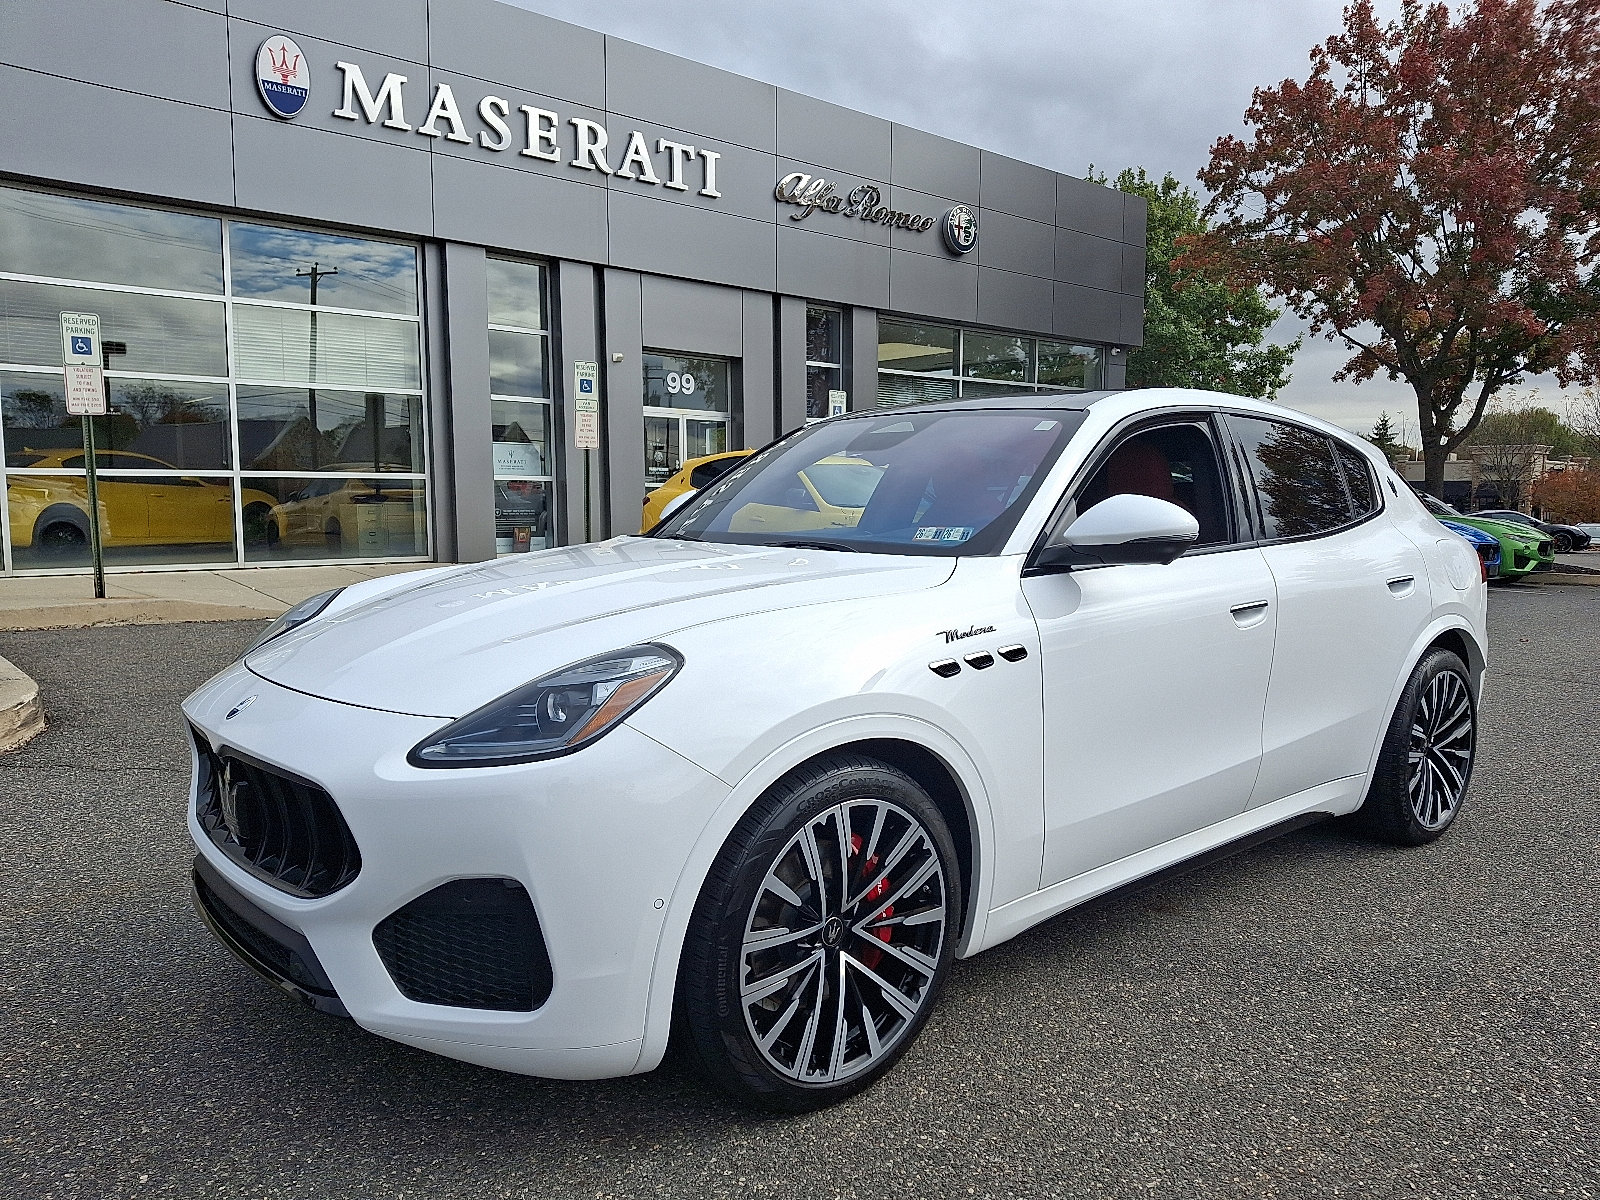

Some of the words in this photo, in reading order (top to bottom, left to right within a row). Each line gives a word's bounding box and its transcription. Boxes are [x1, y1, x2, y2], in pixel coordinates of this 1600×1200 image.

[264, 82, 306, 97] MASERATI
[333, 60, 721, 198] MASERATI
[775, 172, 846, 221] Alfa
[844, 184, 938, 233] Romeo
[63, 316, 97, 326] RESERVED
[65, 326, 95, 335] PARKING
[666, 372, 695, 395] 99
[936, 624, 997, 644] Modena
[716, 945, 729, 1017] Continental
